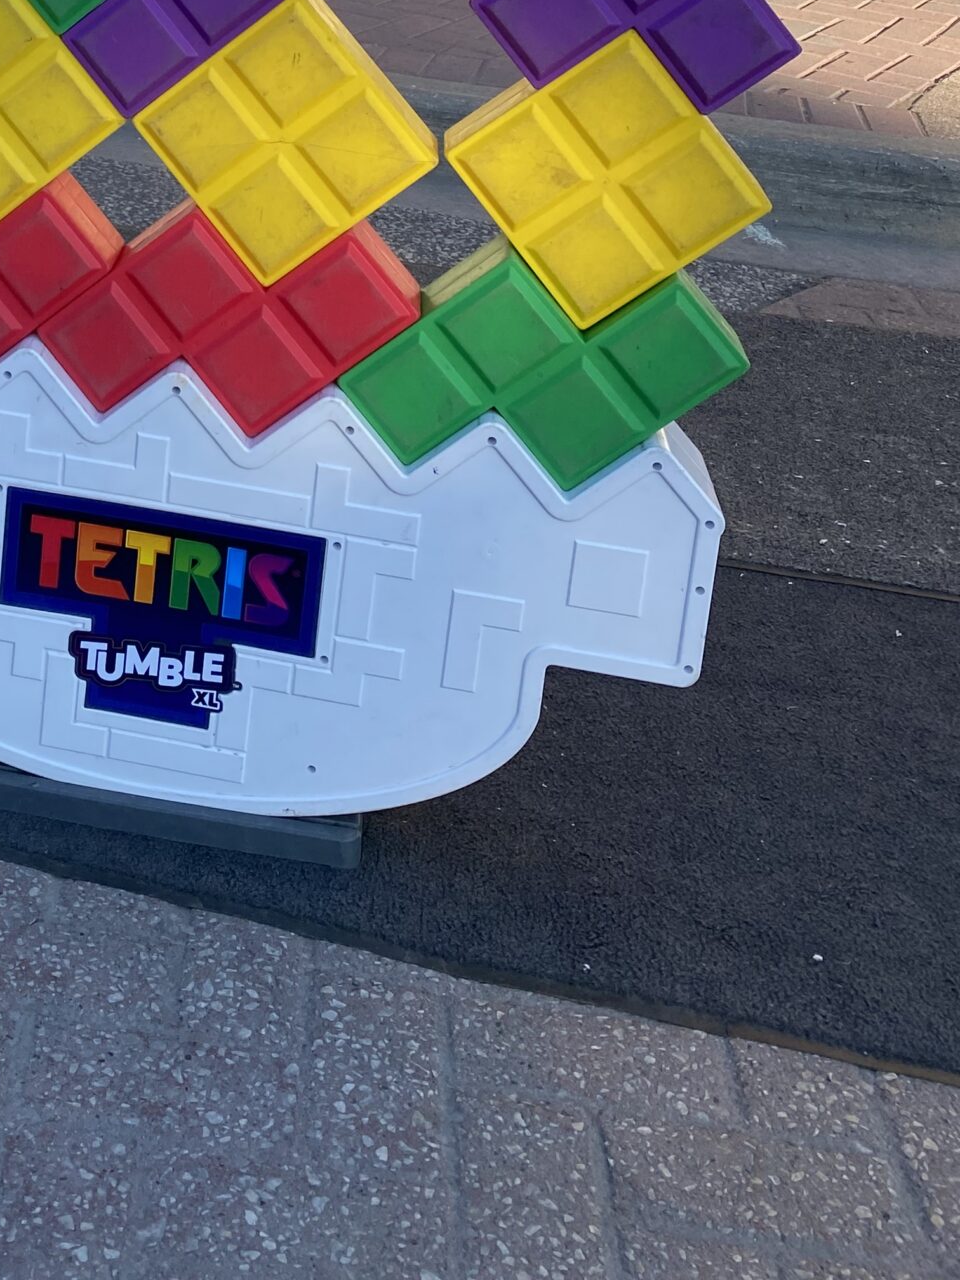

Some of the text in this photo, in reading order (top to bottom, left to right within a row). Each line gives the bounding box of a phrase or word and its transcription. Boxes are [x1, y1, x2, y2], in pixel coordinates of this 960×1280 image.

[30, 514, 294, 626] TETRIS
[80, 641, 225, 688] TUMBLE
[191, 688, 221, 710] XL
